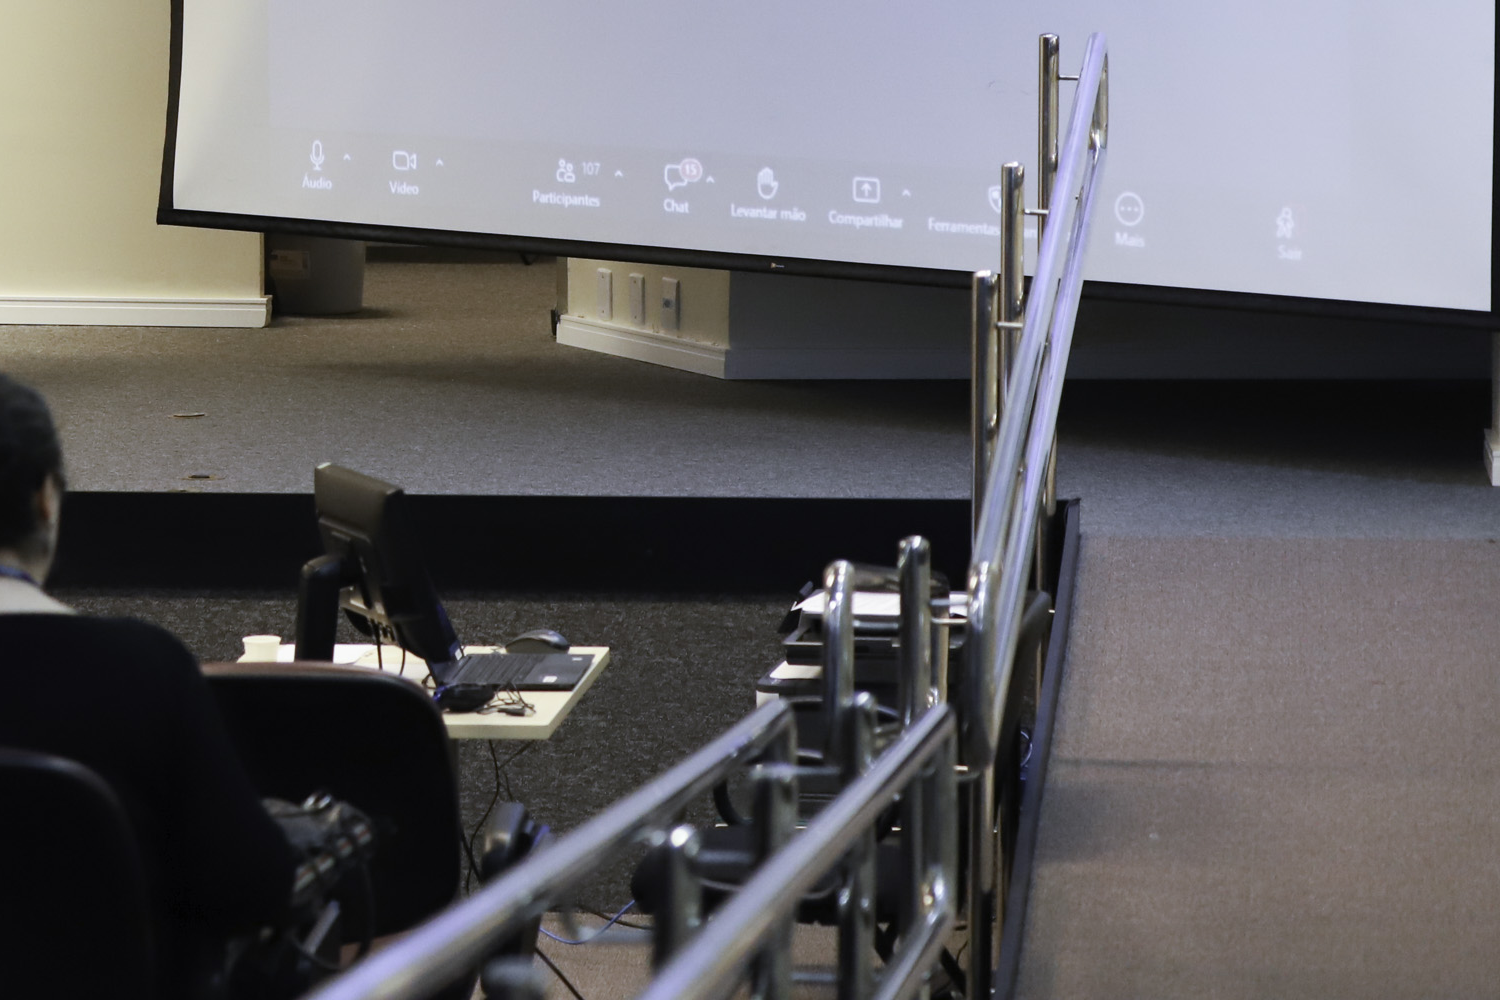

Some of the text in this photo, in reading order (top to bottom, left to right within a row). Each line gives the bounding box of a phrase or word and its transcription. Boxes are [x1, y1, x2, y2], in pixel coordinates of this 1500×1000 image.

[582, 161, 601, 176] 107
[685, 163, 698, 176] 15
[532, 189, 601, 208] Participantes
[663, 198, 690, 214] Chat
[730, 203, 807, 222] Levantar mão
[828, 210, 904, 230] Compartilhar
[928, 216, 1001, 236] Ferramentas
[1114, 231, 1146, 248] Mais
